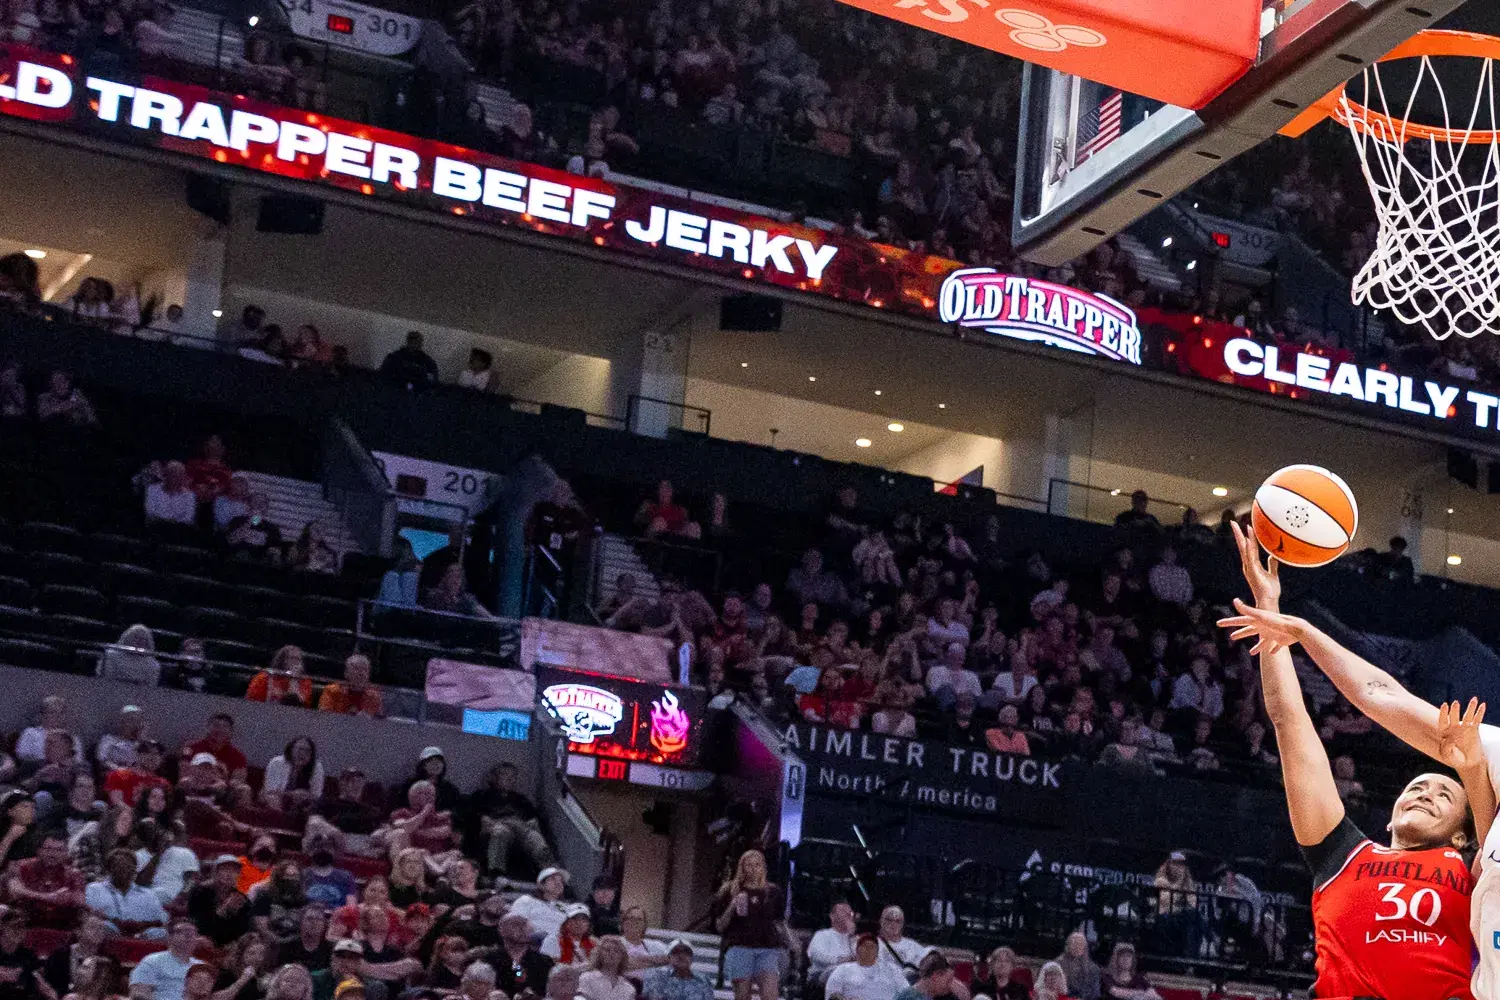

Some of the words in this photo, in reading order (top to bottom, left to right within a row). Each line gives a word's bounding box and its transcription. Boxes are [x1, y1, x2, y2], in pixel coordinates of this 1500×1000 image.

[366, 14, 411, 40] 301
[87, 76, 421, 189] TRAPPER
[433, 157, 616, 227] BEEF
[626, 205, 838, 280] JERKY
[948, 278, 1003, 322] OLD
[1004, 276, 1142, 365] TRAPPER
[1223, 338, 1459, 418] CLEARLY
[600, 761, 626, 779] EXIT
[785, 723, 925, 768] AIMLER
[950, 748, 1062, 788] TRUCK
[659, 771, 685, 788] 101
[1375, 882, 1442, 927] 30
[1365, 929, 1448, 947] LASHIFY
